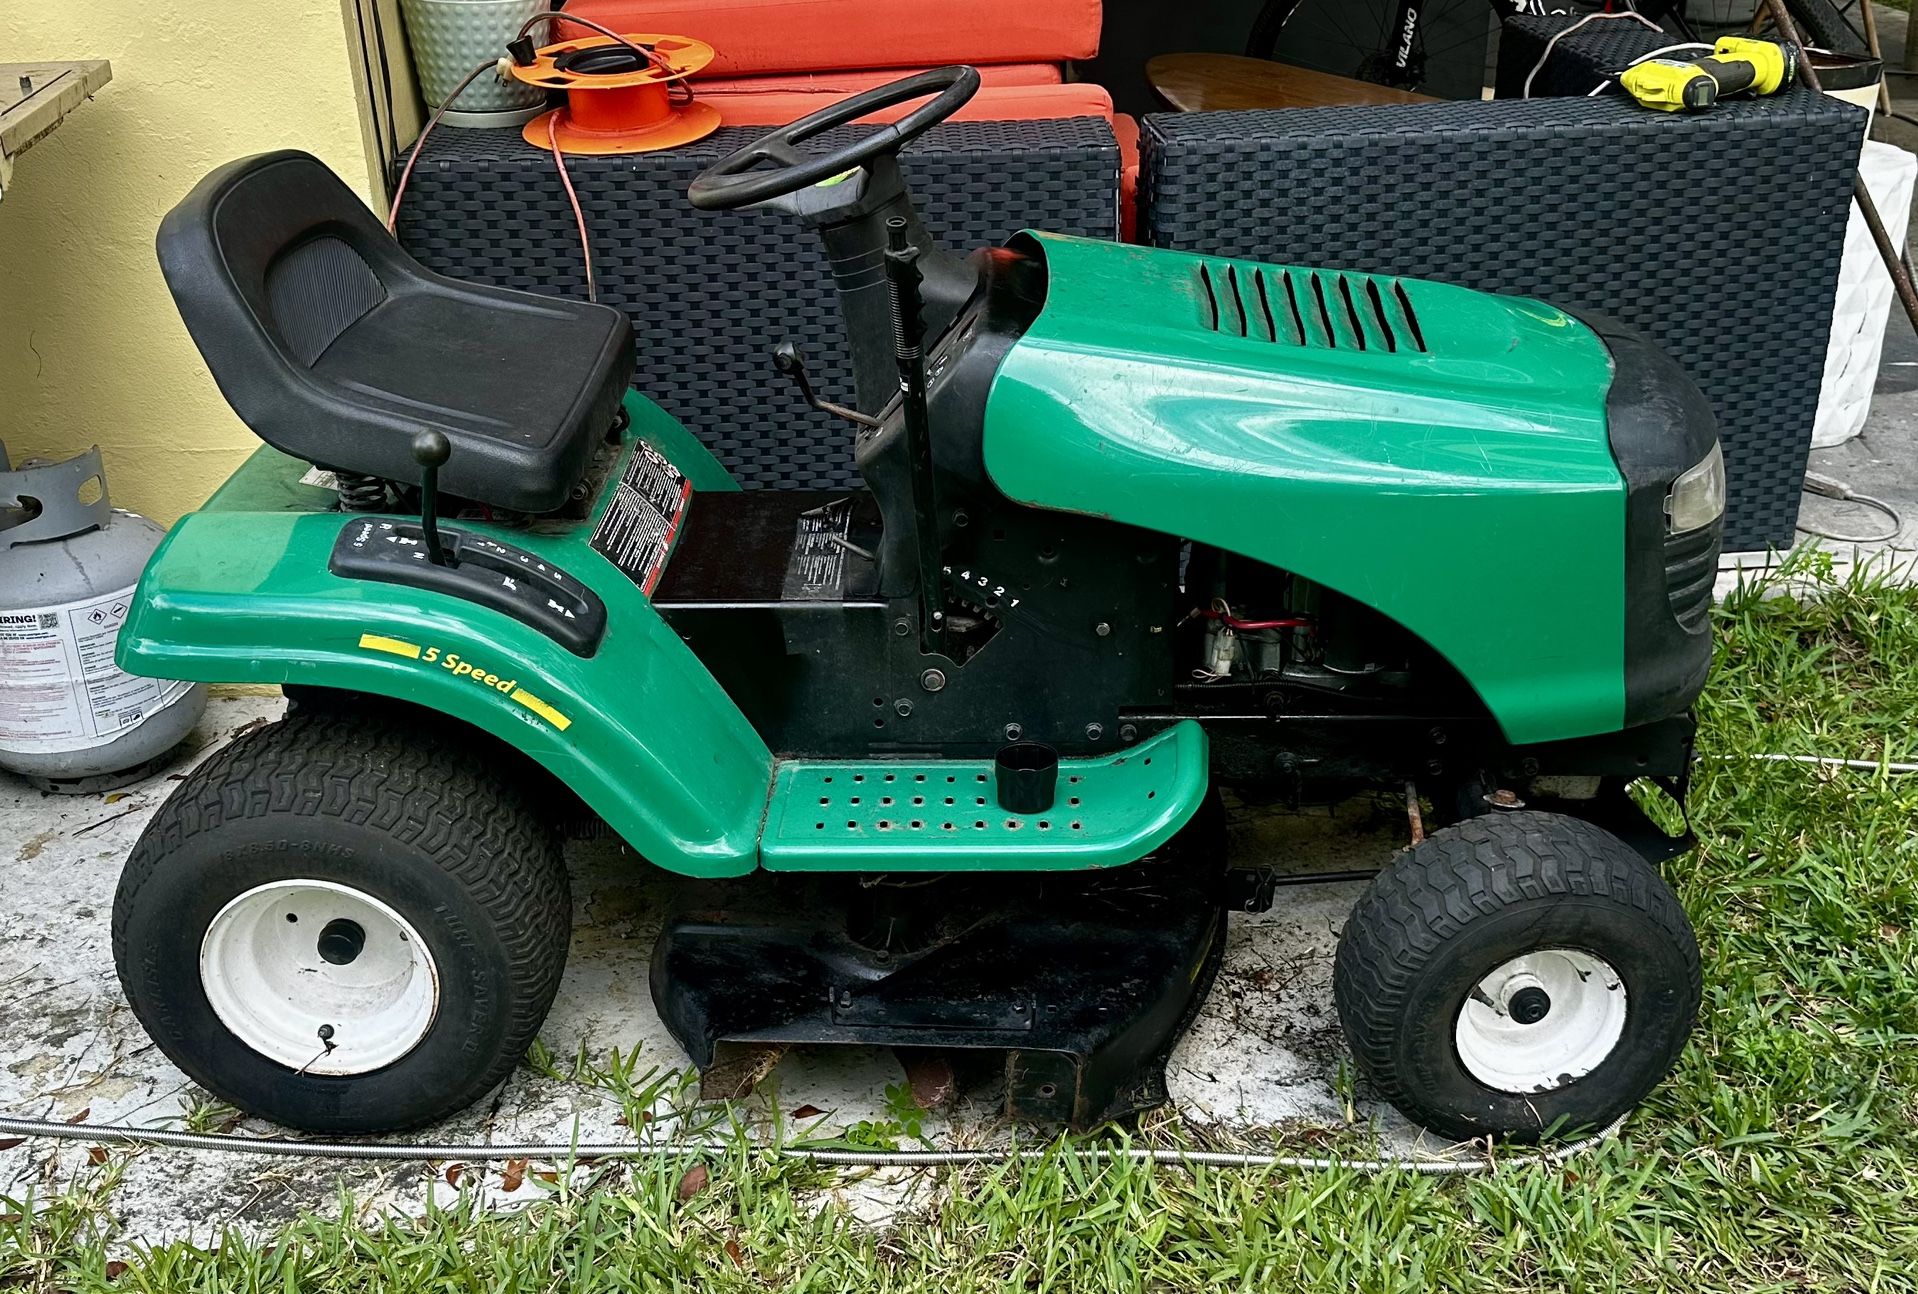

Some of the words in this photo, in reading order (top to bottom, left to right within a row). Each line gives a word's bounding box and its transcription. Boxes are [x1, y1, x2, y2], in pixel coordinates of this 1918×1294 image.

[1396, 8, 1417, 67] VILANO
[356, 523, 373, 543] Speed
[413, 551, 425, 559] N
[496, 546, 506, 554] 2
[520, 555, 529, 563] 3
[553, 571, 562, 580] 5
[942, 566, 952, 575] 5
[960, 570, 971, 580] 4
[978, 576, 988, 587] 3
[993, 585, 1005, 597] 2
[1010, 598, 1020, 608] 1
[421, 646, 441, 662] 5
[441, 653, 517, 694] Speed
